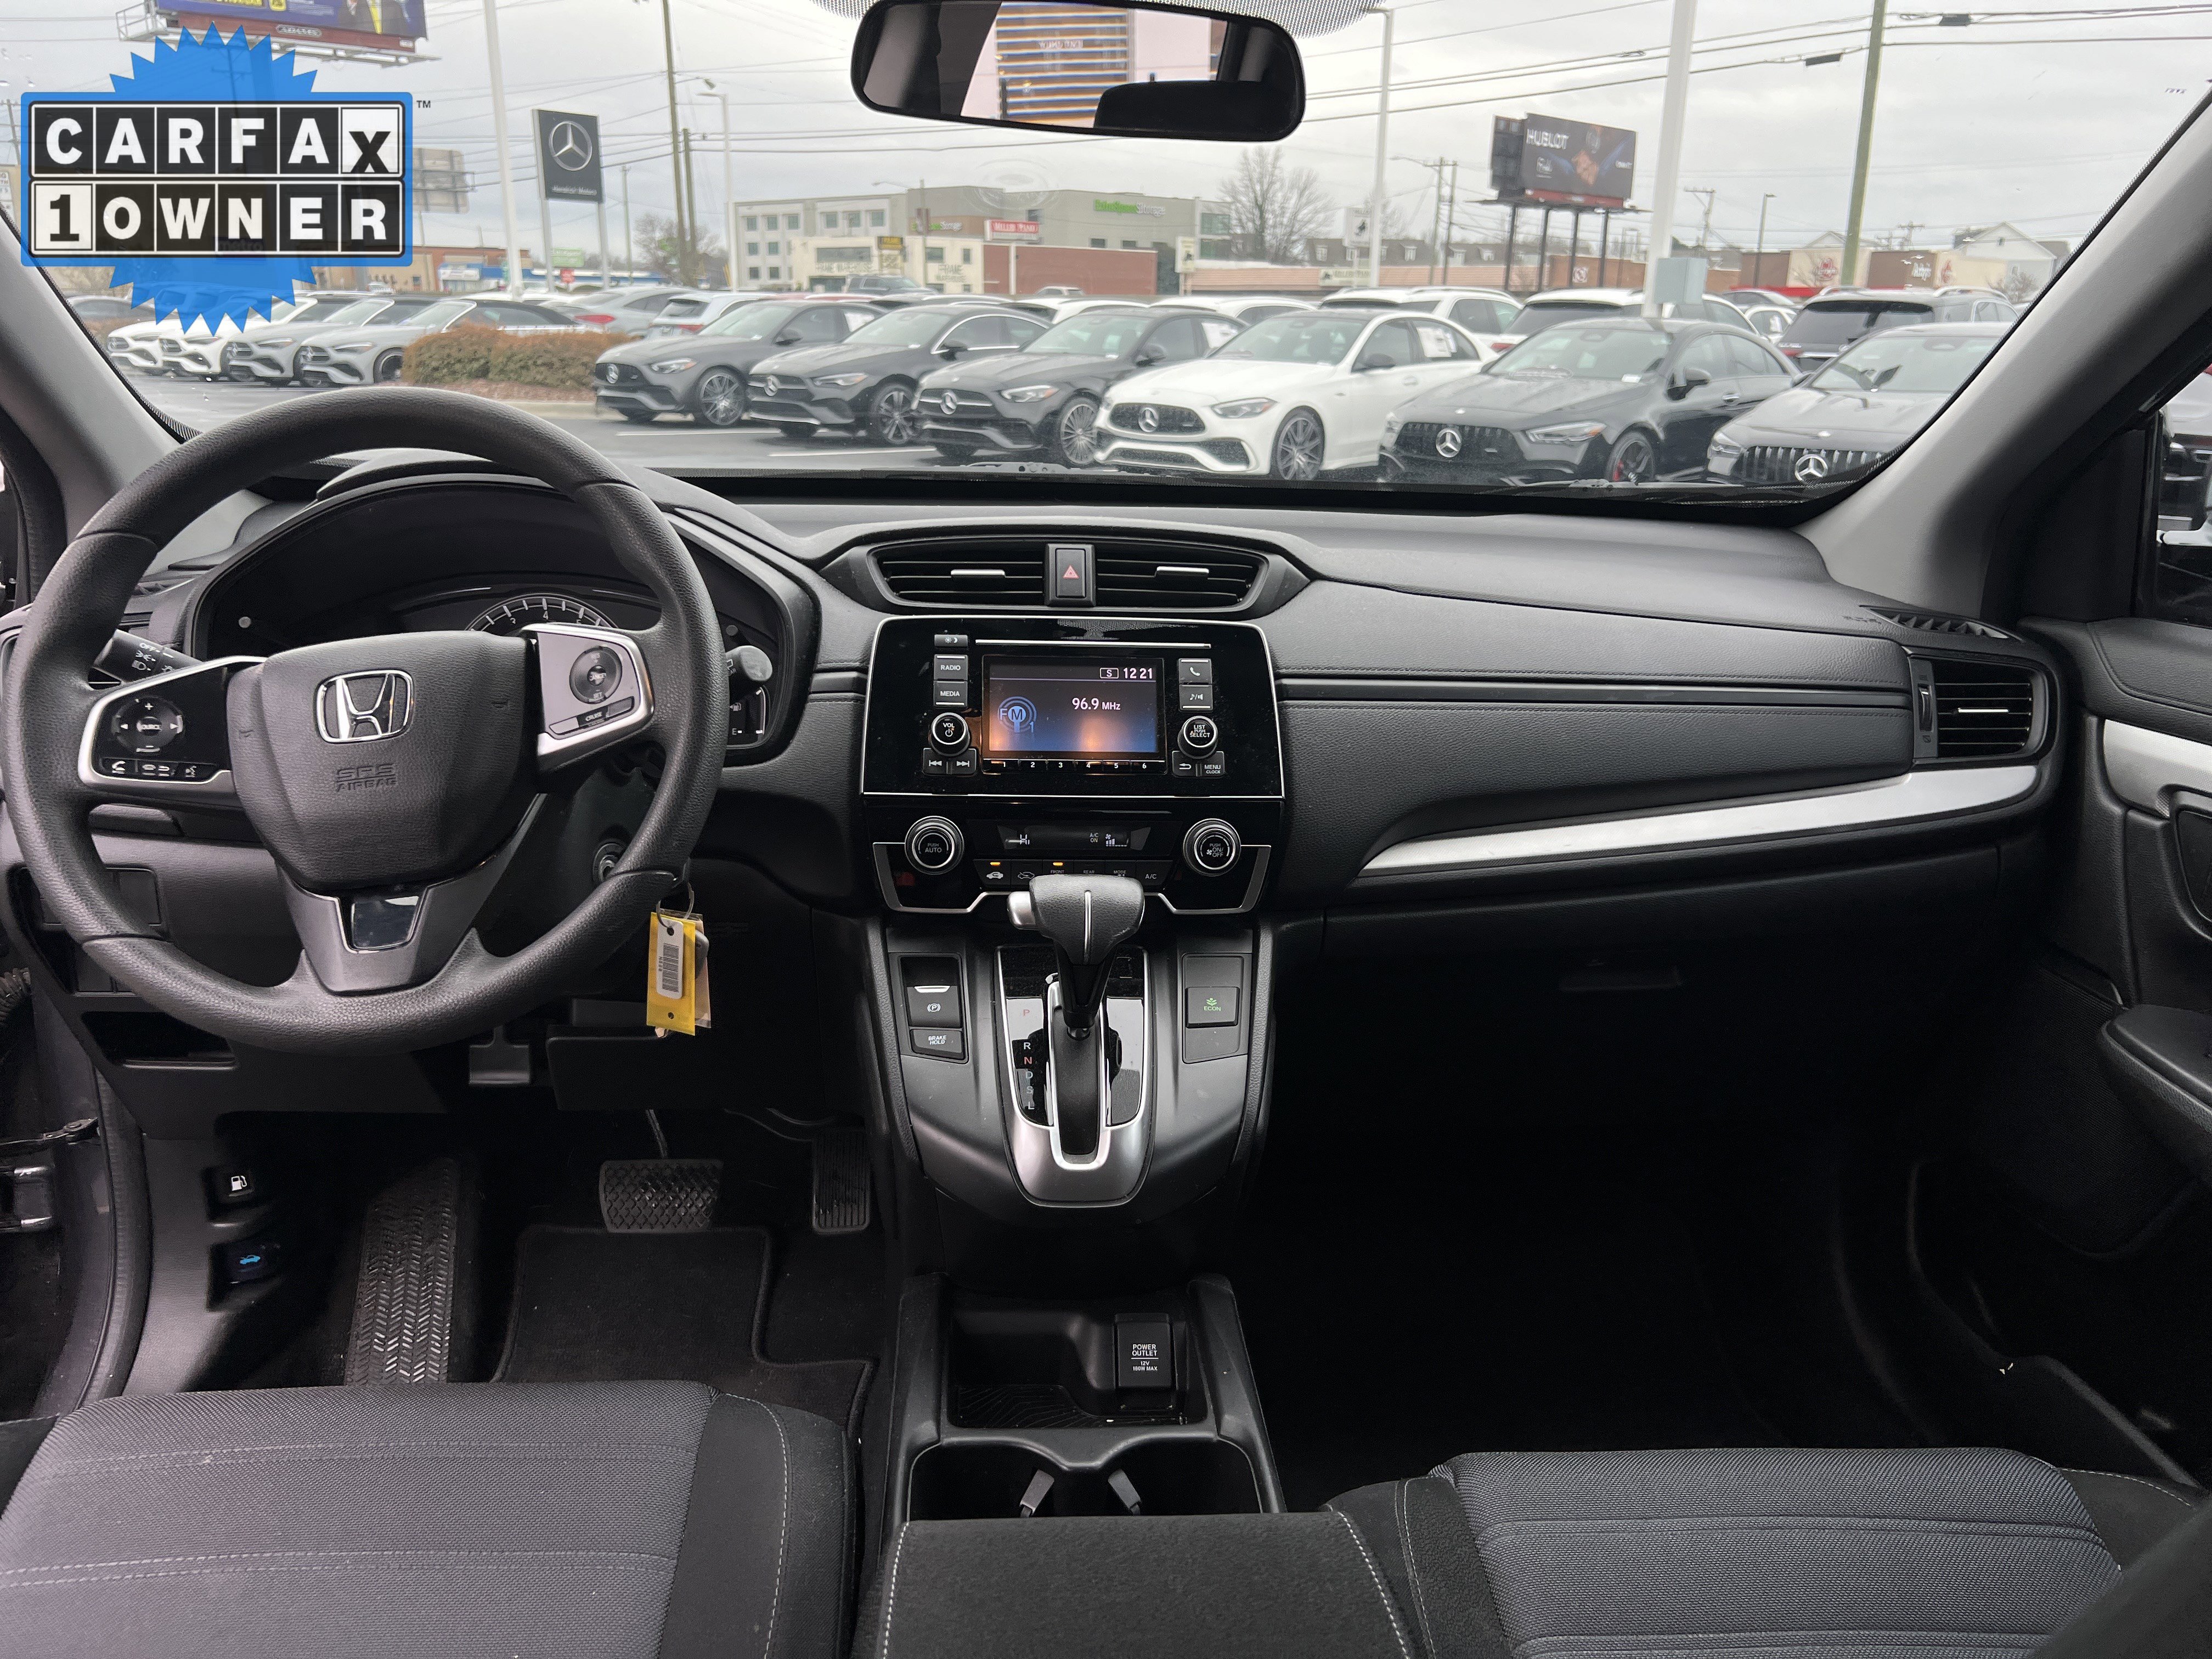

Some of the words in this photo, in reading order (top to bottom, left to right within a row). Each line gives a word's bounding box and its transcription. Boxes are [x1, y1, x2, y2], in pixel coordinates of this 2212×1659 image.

[1526, 128, 1570, 150] HUBLOT
[543, 611, 549, 620] 4
[1071, 697, 1099, 710] 96.9
[1102, 702, 1121, 710] MHz
[732, 727, 737, 736] E
[1026, 1086, 1034, 1094] S
[1028, 1101, 1035, 1109] L
